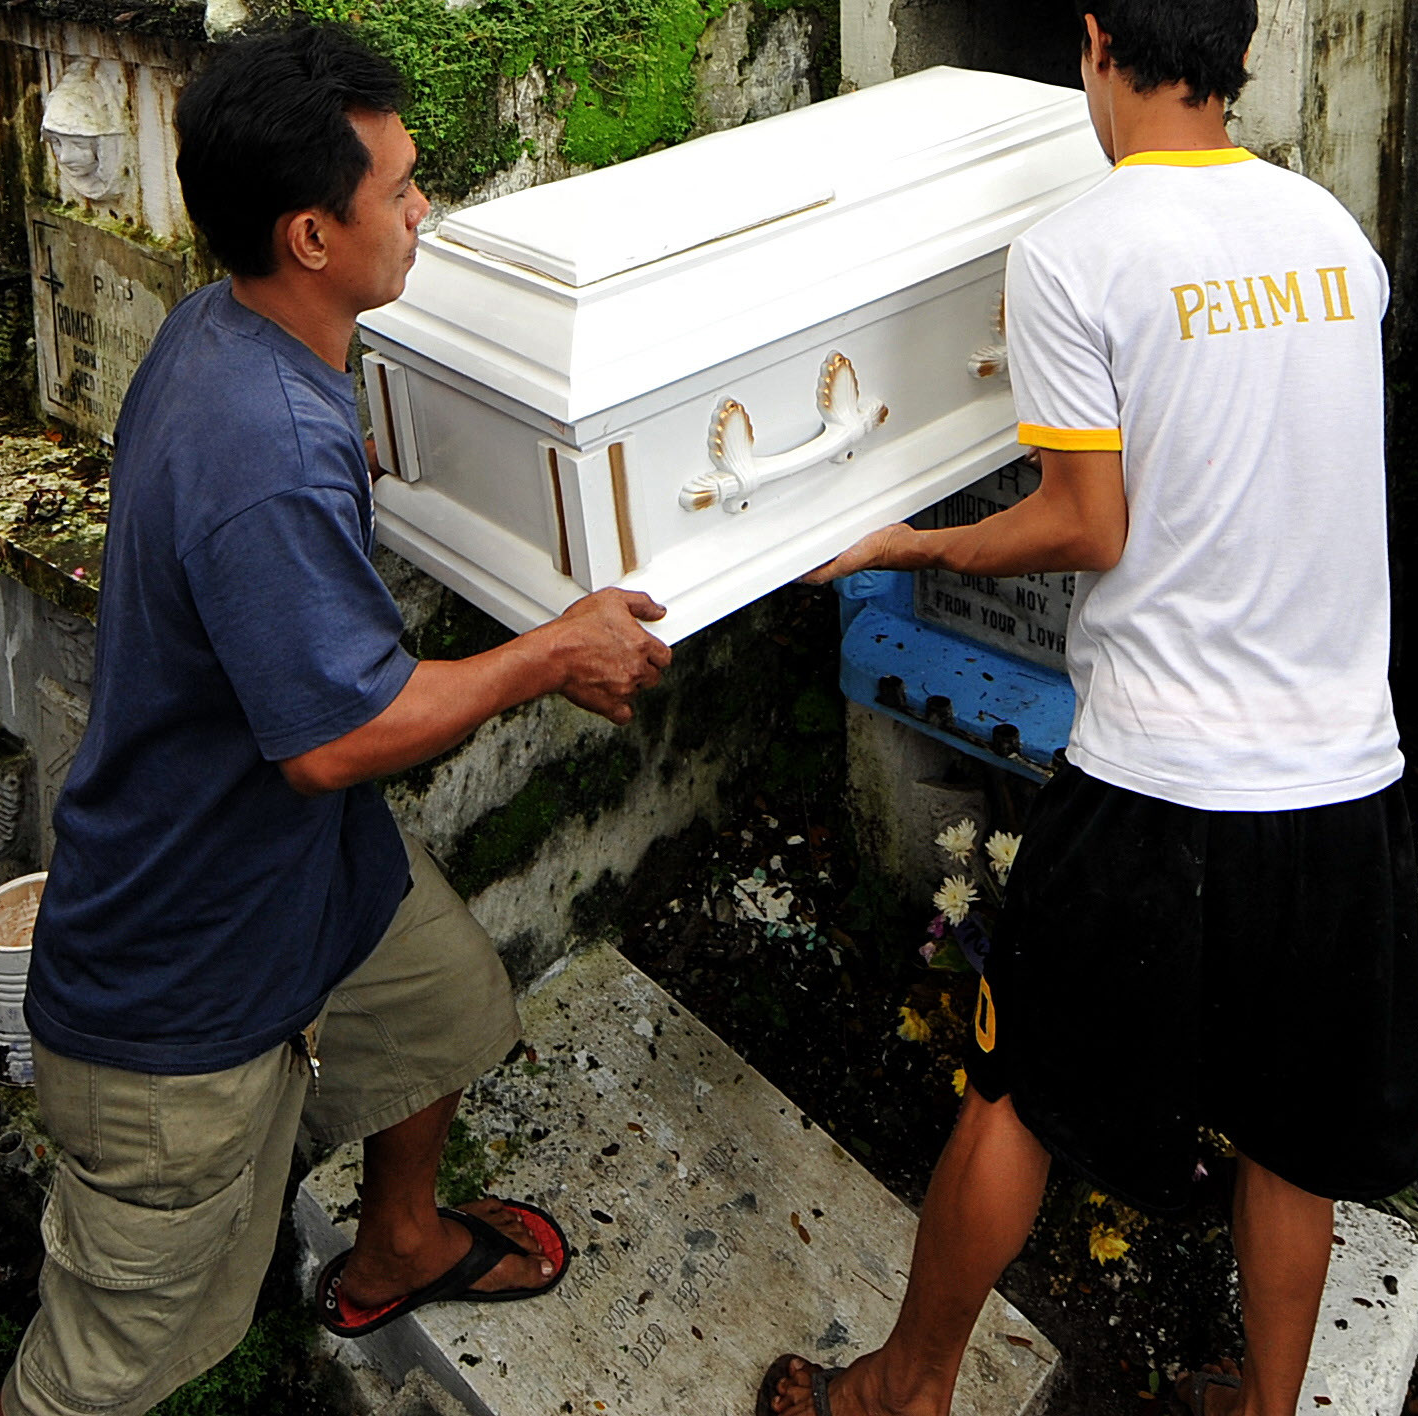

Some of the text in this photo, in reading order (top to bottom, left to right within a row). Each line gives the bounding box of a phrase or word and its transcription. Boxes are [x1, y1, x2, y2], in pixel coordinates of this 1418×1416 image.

[57, 302, 95, 346] ROMEO
[1170, 267, 1355, 340] PEHM II
[935, 590, 1017, 636] FROM YOUR
[1016, 586, 1049, 615] NOV.
